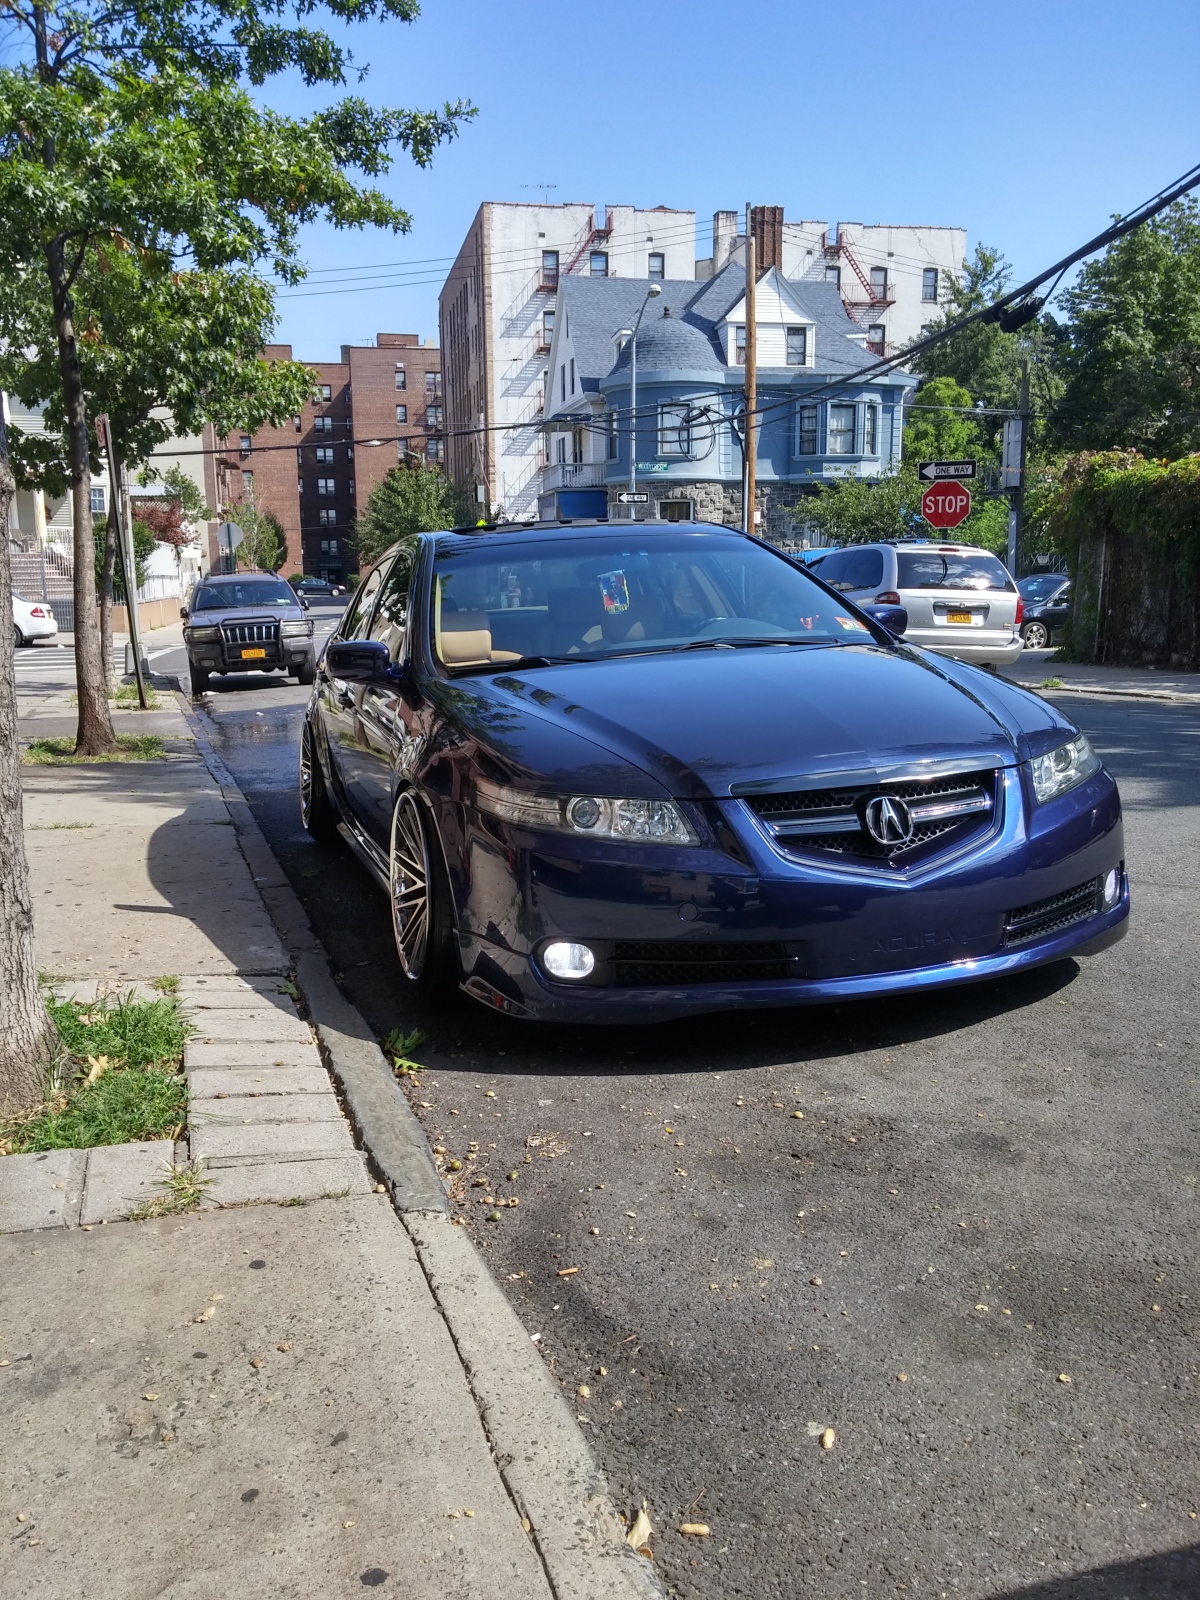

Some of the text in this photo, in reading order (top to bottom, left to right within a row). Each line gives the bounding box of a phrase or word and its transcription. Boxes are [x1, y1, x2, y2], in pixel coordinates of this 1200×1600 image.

[935, 465, 970, 475] ONE WAY
[925, 495, 967, 514] STOP
[872, 928, 956, 954] ACURA
